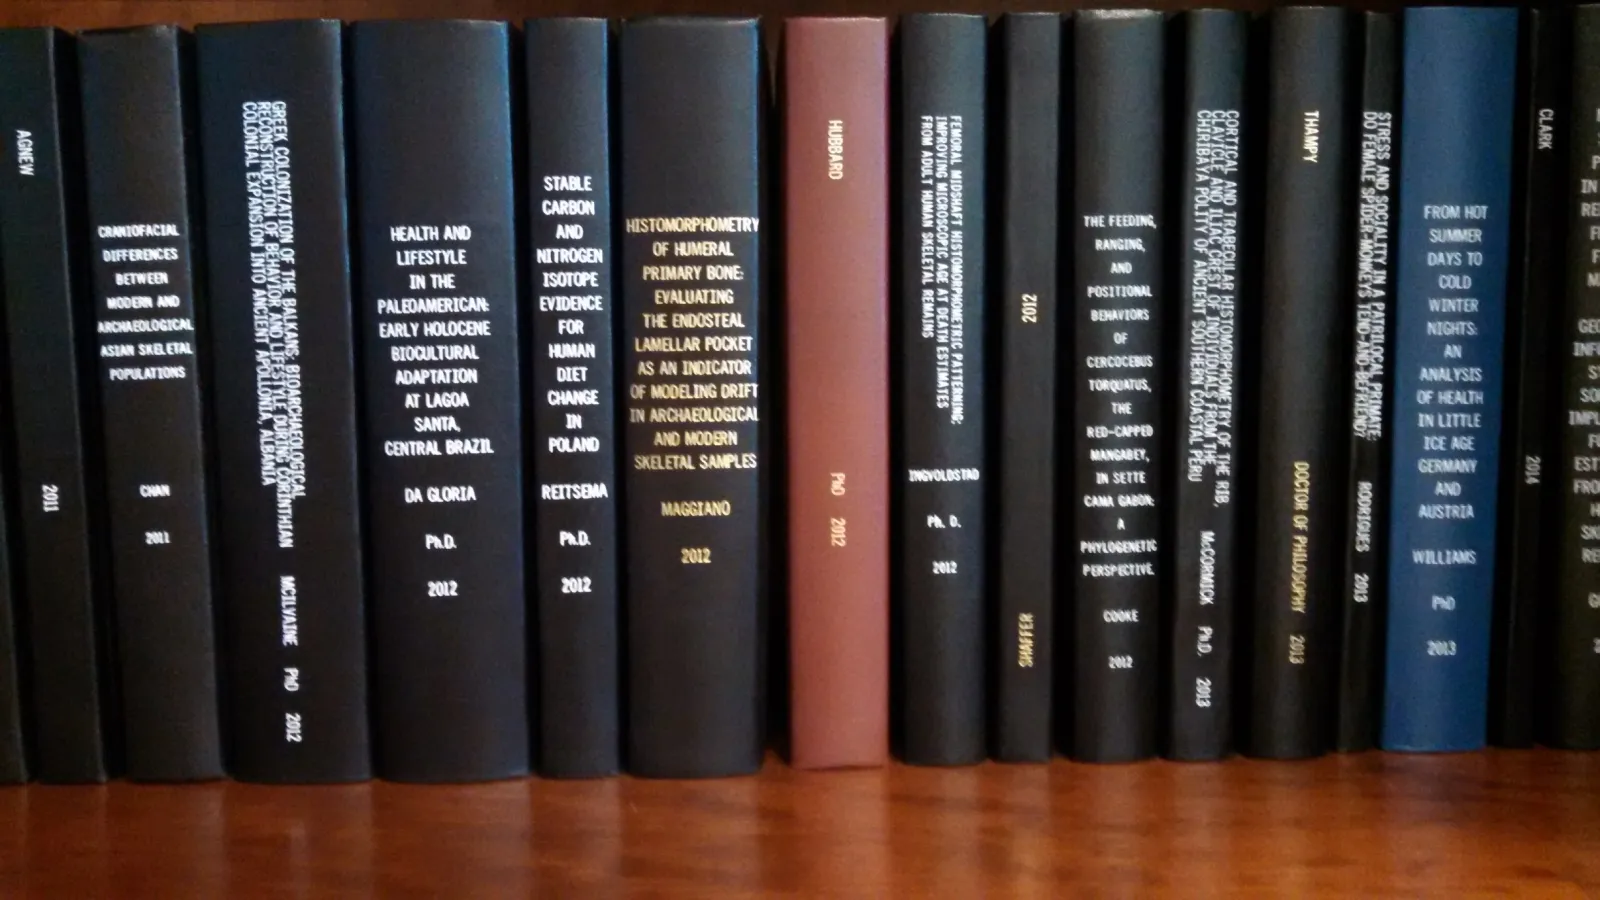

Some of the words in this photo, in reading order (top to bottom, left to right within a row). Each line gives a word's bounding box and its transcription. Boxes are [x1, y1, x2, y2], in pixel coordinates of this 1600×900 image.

[921, 116, 933, 145] FROM
[1303, 111, 1319, 162] THAMPY
[1539, 109, 1554, 149] CLARK
[936, 116, 948, 178] IMPROVING
[950, 116, 962, 165] FEMORAL
[17, 130, 34, 175] AGNEW
[828, 120, 843, 179] HUBBARD
[921, 151, 933, 185] ADULT
[544, 176, 592, 191] STABLE
[950, 170, 962, 225] MIDSHAFT
[542, 200, 595, 215] CARBON
[921, 190, 934, 227] HUMAN
[1424, 205, 1460, 219] FROM
[1464, 205, 1488, 219] HOT
[627, 216, 759, 232] HISTOMORPHOMETRY
[936, 183, 949, 258] MICROSCOPIC
[1084, 215, 1105, 227] THE
[1108, 214, 1156, 228] FEEDING,
[98, 224, 180, 238] CRANIOFACIAL
[391, 226, 439, 241] HEALTH
[444, 225, 471, 240] AND
[556, 224, 583, 239] AND
[1429, 228, 1482, 243] SUMMER
[653, 242, 669, 256] OF
[675, 241, 734, 256] HUMERAL
[1095, 238, 1145, 252] RANGING,
[103, 247, 178, 262] DIFFERENCES
[397, 249, 467, 265] LIFESTYLE
[537, 247, 603, 263] NITROGEN
[921, 232, 934, 285] SKELETAL
[1427, 252, 1461, 266] DAYS
[1467, 251, 1482, 266] TO
[643, 266, 702, 280] PRIMARY
[936, 263, 949, 283] AGE
[1111, 262, 1132, 273] AND
[116, 272, 168, 285] BETWEEN
[410, 274, 426, 289] IN
[430, 274, 455, 288] THE
[543, 271, 599, 287] ISOTOPE
[1438, 274, 1471, 289] COLD
[655, 288, 734, 304] EVALUATING
[937, 288, 948, 302] AT
[951, 231, 963, 349] HISTOMORPHOMETRIC
[1087, 285, 1152, 298] POSITIONAL
[107, 296, 153, 309] MODERN
[157, 295, 180, 307] AND
[540, 295, 603, 311] EVIDENCE
[1022, 294, 1037, 322] 2012
[1428, 298, 1478, 312] WINTER
[643, 314, 667, 328] THE
[673, 312, 745, 328] ENDOSTEAL
[922, 289, 934, 338] REMAINS
[1091, 308, 1149, 321] BEHAVIORS
[98, 318, 194, 333] ARCHAEOLOGICAL
[379, 322, 419, 338] EARLY
[424, 320, 491, 336] HOLOCENE
[559, 319, 584, 334] FOR
[936, 307, 949, 342] DEATH
[635, 337, 700, 352] LAMELLAR
[705, 336, 753, 351] POCKET
[1113, 332, 1128, 344] OF
[101, 345, 135, 357] ASIAN
[138, 342, 193, 356] SKELETAL
[391, 344, 479, 361] BIOCULTURAL
[549, 343, 595, 358] HUMAN
[1444, 344, 1461, 358] AN
[638, 361, 654, 376] AS
[660, 361, 677, 375] AN
[683, 359, 752, 375] INDICATOR
[1087, 355, 1153, 368] CERCOCEBUS
[110, 366, 186, 380] POPULATIONS
[396, 368, 478, 385] ADAPTATION
[557, 367, 588, 382] DIET
[936, 346, 949, 408] ESTIMATES
[1419, 367, 1481, 382] ANALYSIS
[548, 390, 599, 405] CHANGE
[630, 384, 646, 399] OF
[651, 383, 717, 399] MODELING
[721, 383, 758, 399] DRIFT
[1417, 390, 1434, 404] OF
[1438, 390, 1483, 405] HEALTH
[405, 393, 420, 408] AT
[426, 392, 469, 408] LAGOA
[1111, 402, 1132, 414] THE
[566, 414, 582, 429] IN
[630, 408, 645, 422] IN
[651, 406, 758, 422] ARCHAEOLOGICAL
[1418, 413, 1434, 427] IN
[1437, 412, 1480, 428] LITTLE
[654, 431, 680, 446] AND
[685, 430, 738, 445] MODERN
[1087, 424, 1153, 438] RED-CAPPED
[385, 440, 442, 456] CENTRAL
[446, 438, 494, 455] BRAZIL
[549, 437, 600, 453] POLAND
[1424, 436, 1446, 450] ICE
[1451, 436, 1474, 450] AGE
[635, 455, 695, 470] SKELETAL
[700, 453, 757, 469] SAMPLES
[1418, 458, 1477, 473] GERMANY
[909, 468, 979, 482] INGVOLDSTAD
[1096, 472, 1109, 484] IN
[1113, 471, 1145, 484] SETTE
[1525, 456, 1541, 484] 2014
[140, 485, 170, 497] CHAN
[542, 483, 608, 500] REITSEMA
[831, 472, 845, 495] PhD
[1294, 462, 1310, 510] DOCTOR
[1435, 481, 1461, 496] AND
[42, 485, 59, 512] 2011
[405, 488, 423, 503] DA
[427, 486, 476, 502] GLORIA
[1084, 495, 1114, 507] CAMA
[661, 500, 731, 516] MAGGIANO
[1418, 504, 1474, 519] AUSTRIA
[1293, 515, 1308, 531] OF
[1356, 482, 1372, 552] RODRIGUES
[145, 531, 170, 544] 2011
[560, 531, 591, 546] Ph.D.
[831, 518, 846, 547] 2012
[426, 534, 456, 549] Ph.D.
[1081, 540, 1157, 553] PHYLOGENETIC
[682, 548, 711, 563] 2012
[1412, 549, 1476, 565] WILLIAMS
[933, 561, 957, 574] 2012
[1291, 535, 1308, 613] PHILOSOPHY
[428, 580, 458, 597] 2012
[562, 576, 591, 593] 2012
[1354, 574, 1369, 602] 2013
[1432, 595, 1455, 610] PhD
[281, 576, 298, 646] MCILVAINE
[1103, 609, 1138, 622] COOKE
[1019, 613, 1033, 667] SHAFFER
[1427, 640, 1456, 656] 2013
[1289, 635, 1305, 664] 2013
[1109, 655, 1133, 668] 2012
[284, 668, 299, 691] PhD
[1196, 678, 1211, 707] 2013
[286, 713, 302, 742] 2012
